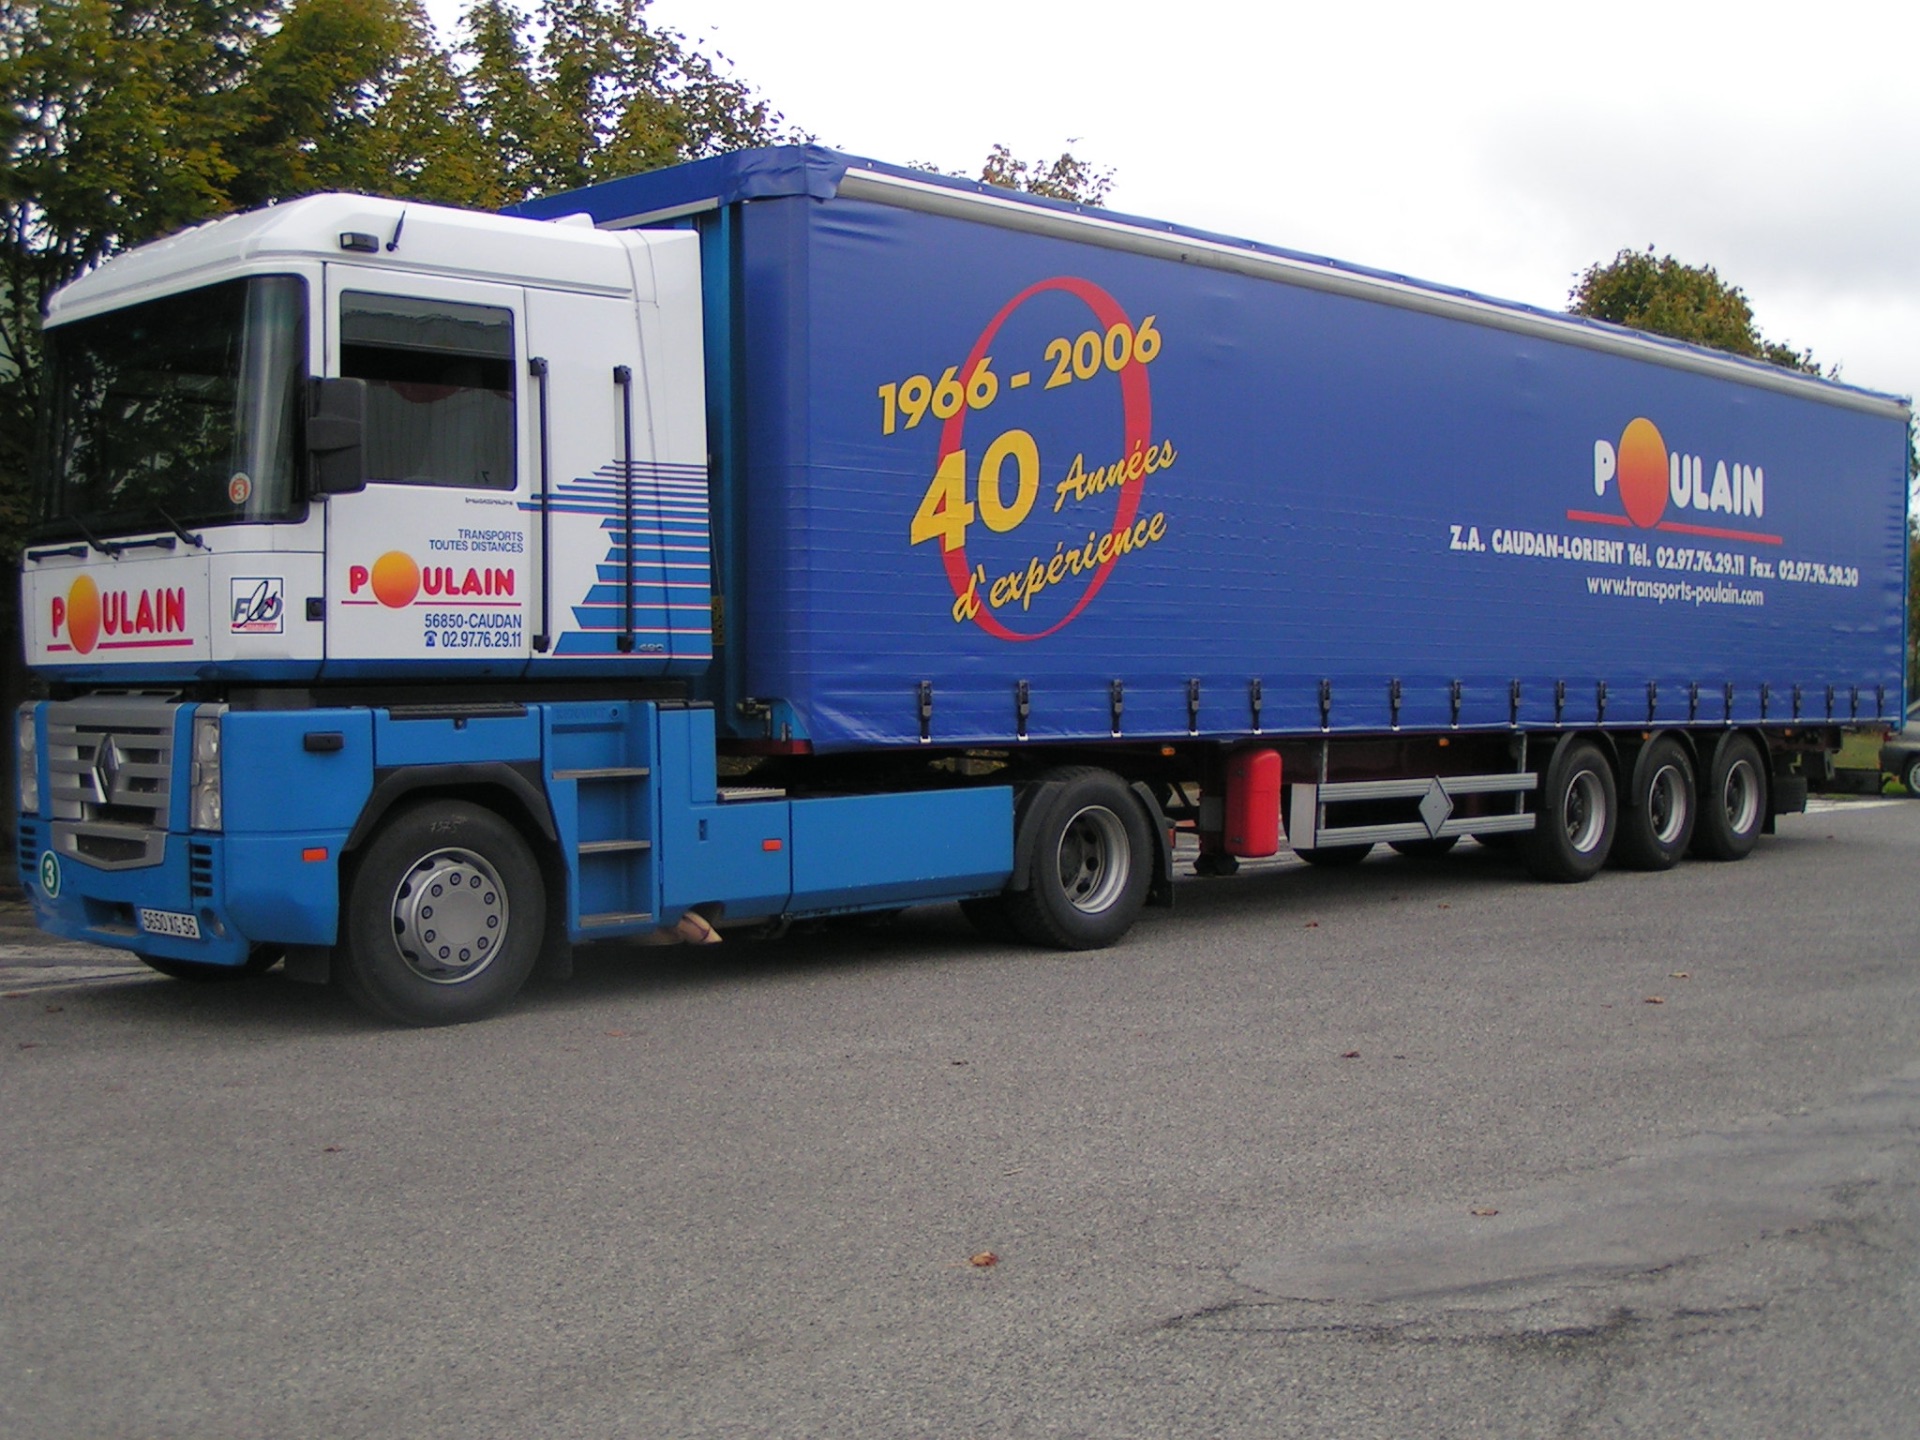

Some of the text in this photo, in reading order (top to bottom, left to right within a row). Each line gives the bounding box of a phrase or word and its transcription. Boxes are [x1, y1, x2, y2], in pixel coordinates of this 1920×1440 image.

[878, 314, 1163, 436] 1966 - 2006
[910, 428, 1179, 554] 40 Années
[1592, 417, 1764, 528] POULAIN
[429, 539, 524, 553] TOUTES DISTANCES
[458, 529, 524, 542] TRANSPORTS
[1449, 525, 1860, 588] Z.A. CAUDAN-LORIENT Tél. 02.97.76.29.11 Fax. 02.97.76.29.30
[348, 550, 515, 609] POULAIN
[951, 511, 1169, 623] d'expérience
[1586, 576, 1764, 607] www.transports-poulain.com
[51, 574, 186, 655] POULAIN
[424, 613, 522, 629] 56850-CAUDAN
[442, 631, 522, 648] 02.97.76.29.11
[44, 859, 56, 889] 3
[143, 911, 168, 932] 5650
[182, 916, 197, 936] 56
